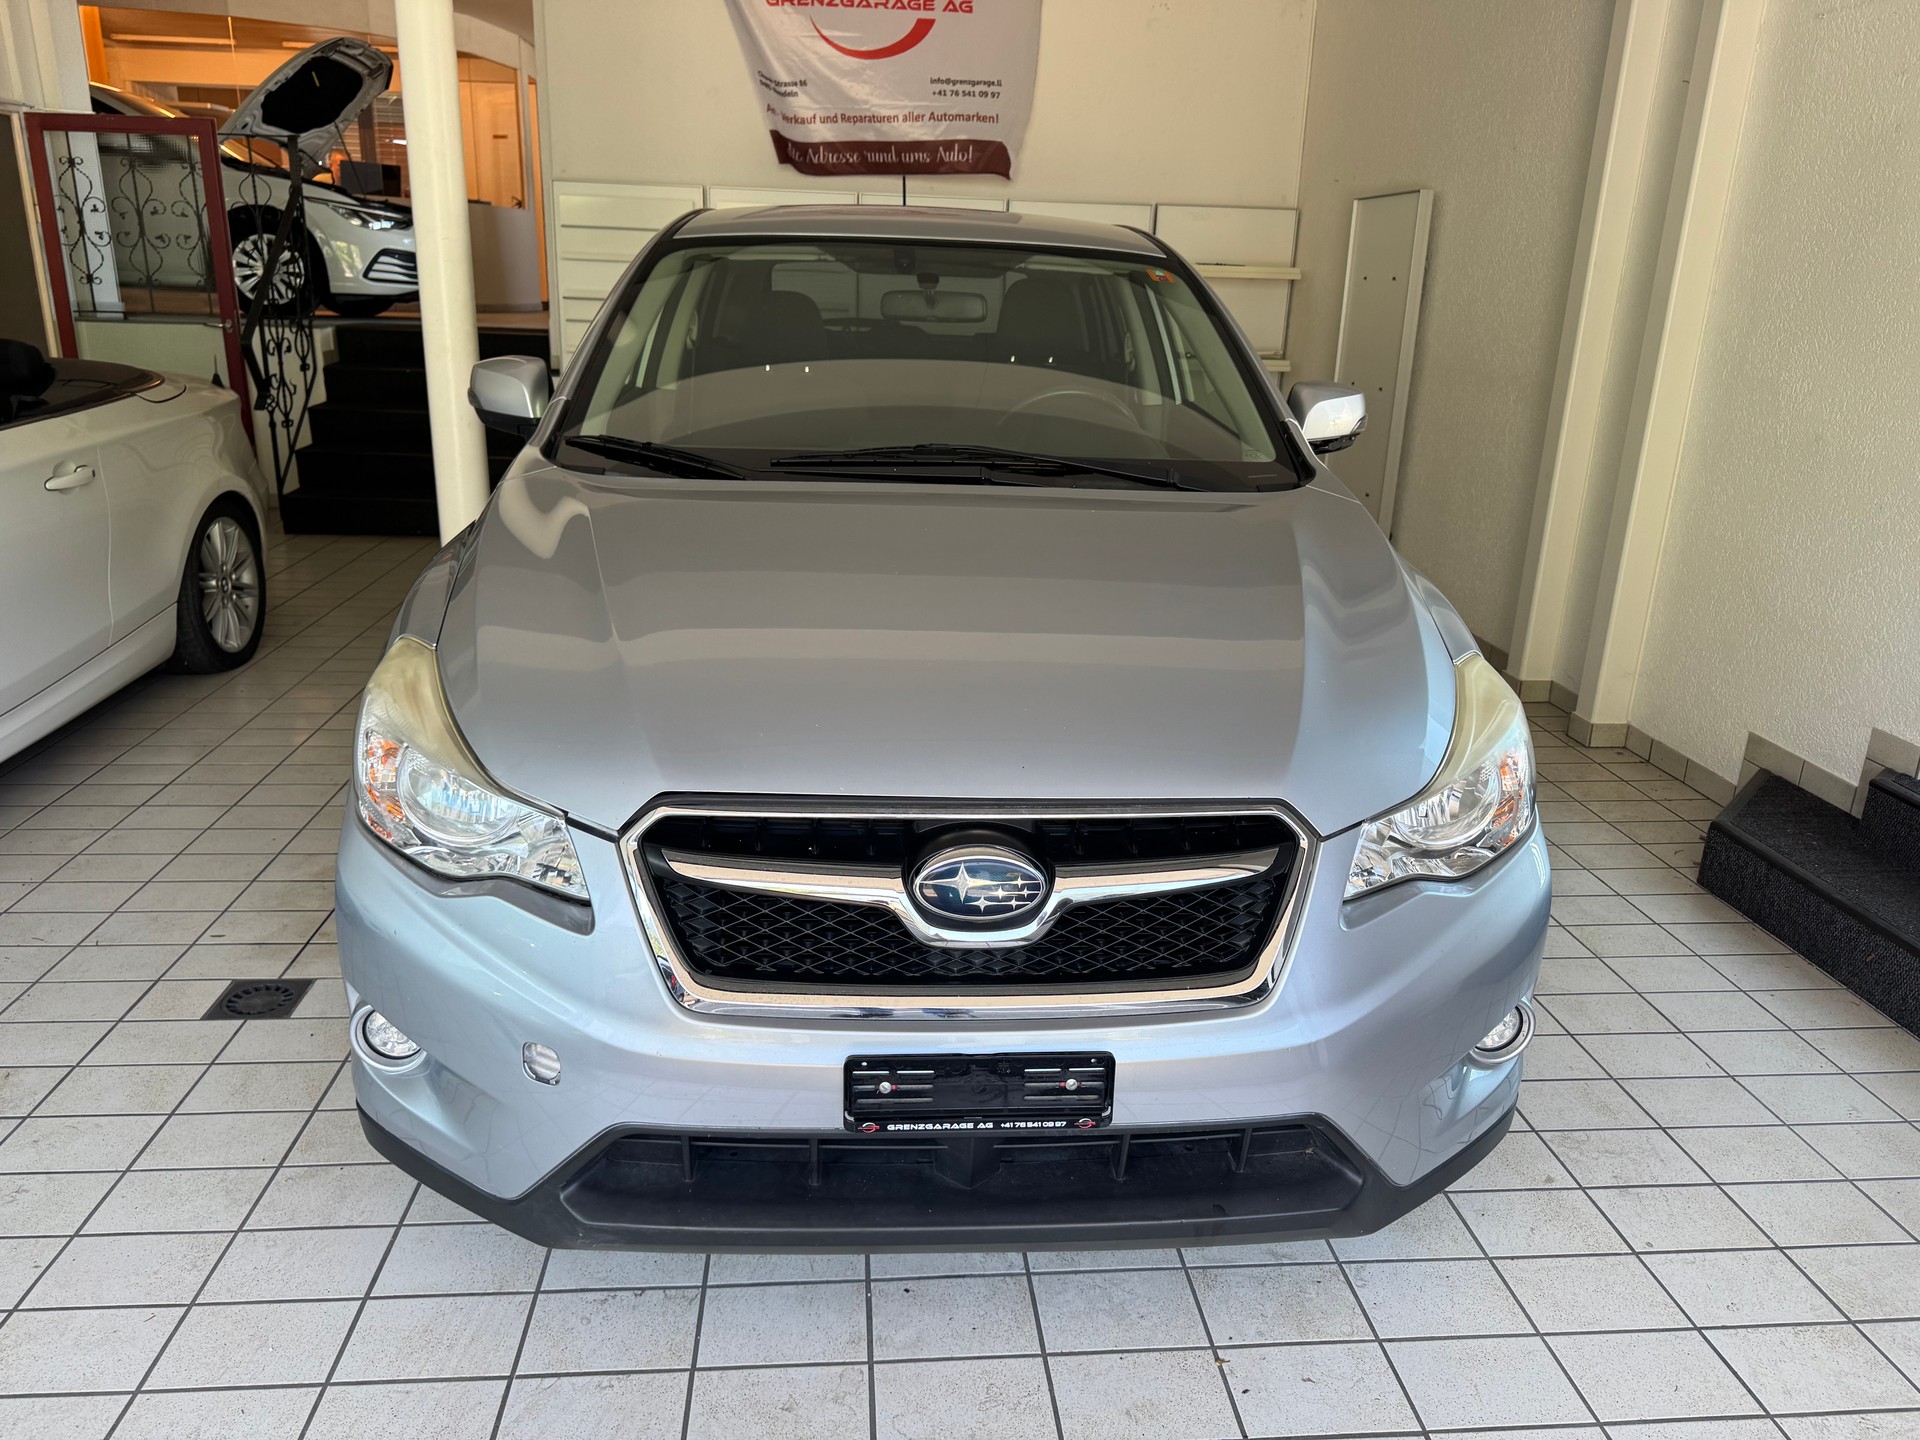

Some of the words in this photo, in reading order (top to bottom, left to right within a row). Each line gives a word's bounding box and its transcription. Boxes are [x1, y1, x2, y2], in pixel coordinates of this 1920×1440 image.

[766, 0, 936, 11] GRENZGARAGE
[942, 0, 974, 14] AG
[932, 89, 947, 97] +41
[949, 89, 960, 98] 76
[961, 89, 976, 98] 541
[978, 90, 989, 99] 09
[990, 91, 1001, 100] 97
[819, 113, 839, 124] und
[840, 113, 899, 126] Reparaturen
[902, 111, 926, 123] aller
[928, 111, 1000, 125] Automarken!
[806, 145, 861, 164] Adresse
[901, 151, 931, 163] ums
[936, 143, 974, 163] Auto!
[886, 1122, 975, 1131] GRENZGARAGE
[976, 1121, 994, 1129] AG
[1000, 1121, 1013, 1129] +41
